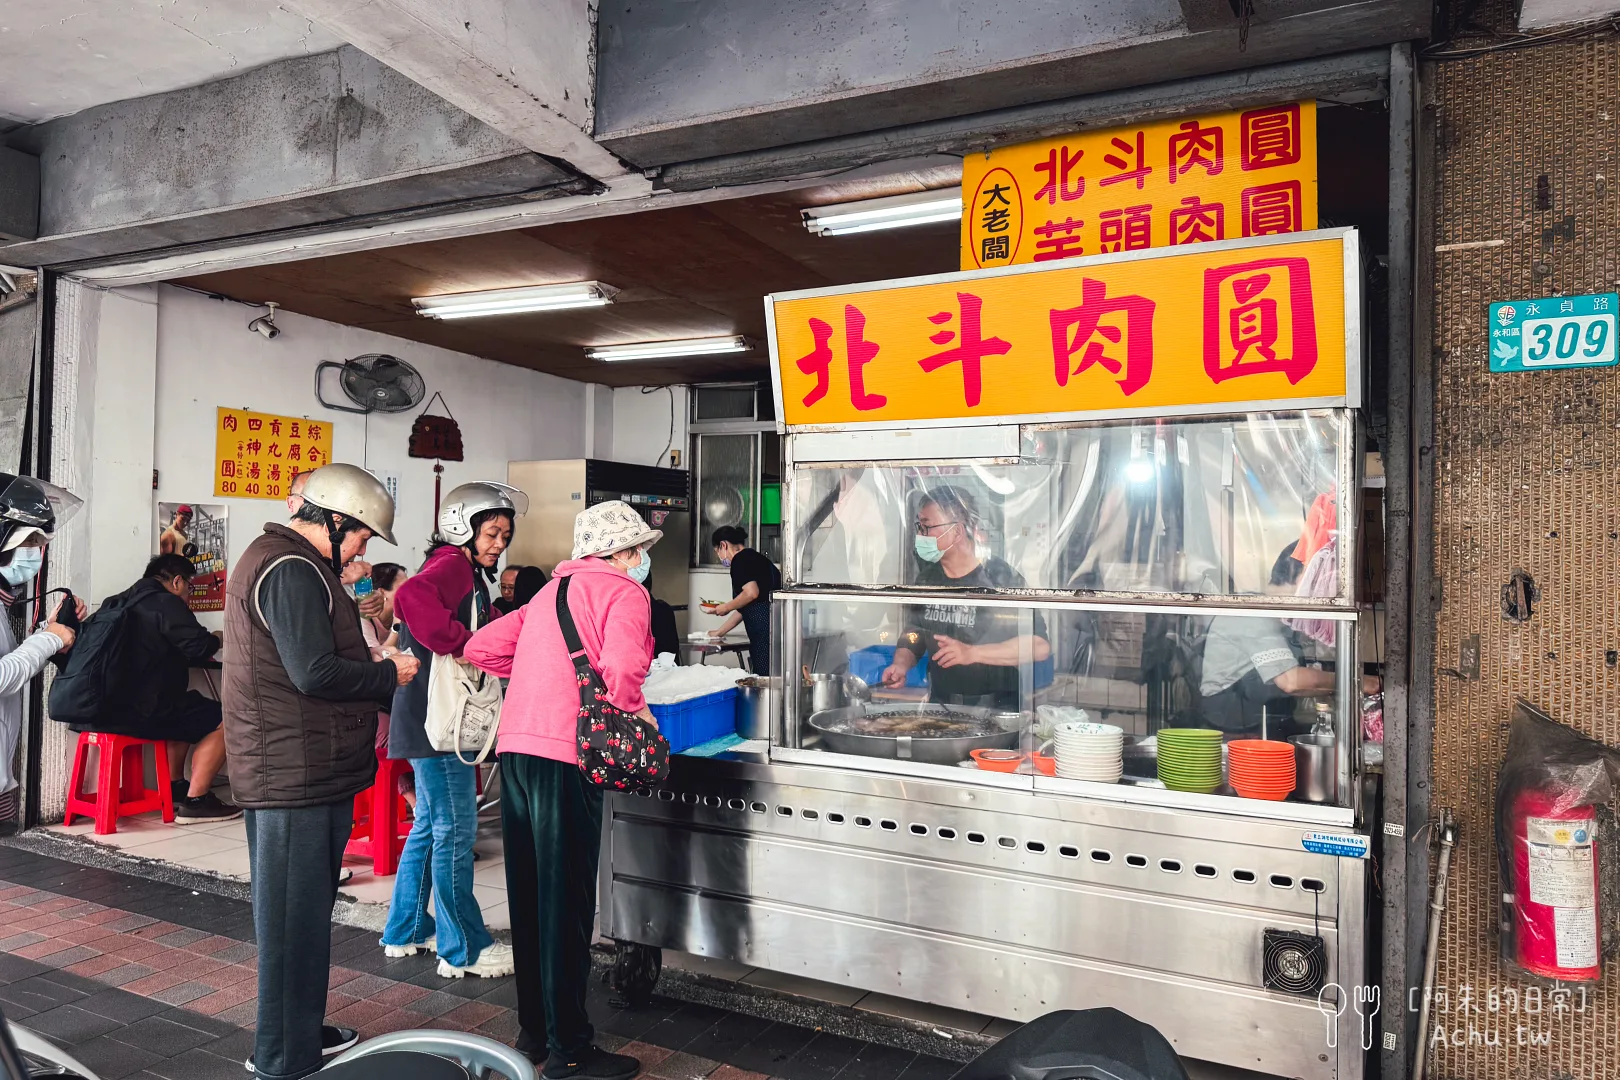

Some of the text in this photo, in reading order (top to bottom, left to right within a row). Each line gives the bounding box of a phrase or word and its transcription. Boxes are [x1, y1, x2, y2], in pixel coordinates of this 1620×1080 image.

[1033, 103, 1301, 206] 北斗肉圓
[981, 184, 1011, 263] 大老闆
[1033, 180, 1303, 263] 芋頭肉圓
[796, 256, 1318, 412] 北斗肉圓
[1492, 327, 1521, 338] 永和區
[1525, 297, 1609, 316] 永貞路
[1528, 320, 1609, 361] 309
[221, 413, 238, 479] 肉圓
[245, 418, 263, 480] 四神湯
[266, 419, 283, 482] 貢丸湯
[307, 424, 323, 472] 綜合
[221, 480, 237, 493] 80
[245, 482, 260, 495] 40
[266, 484, 280, 496] 30
